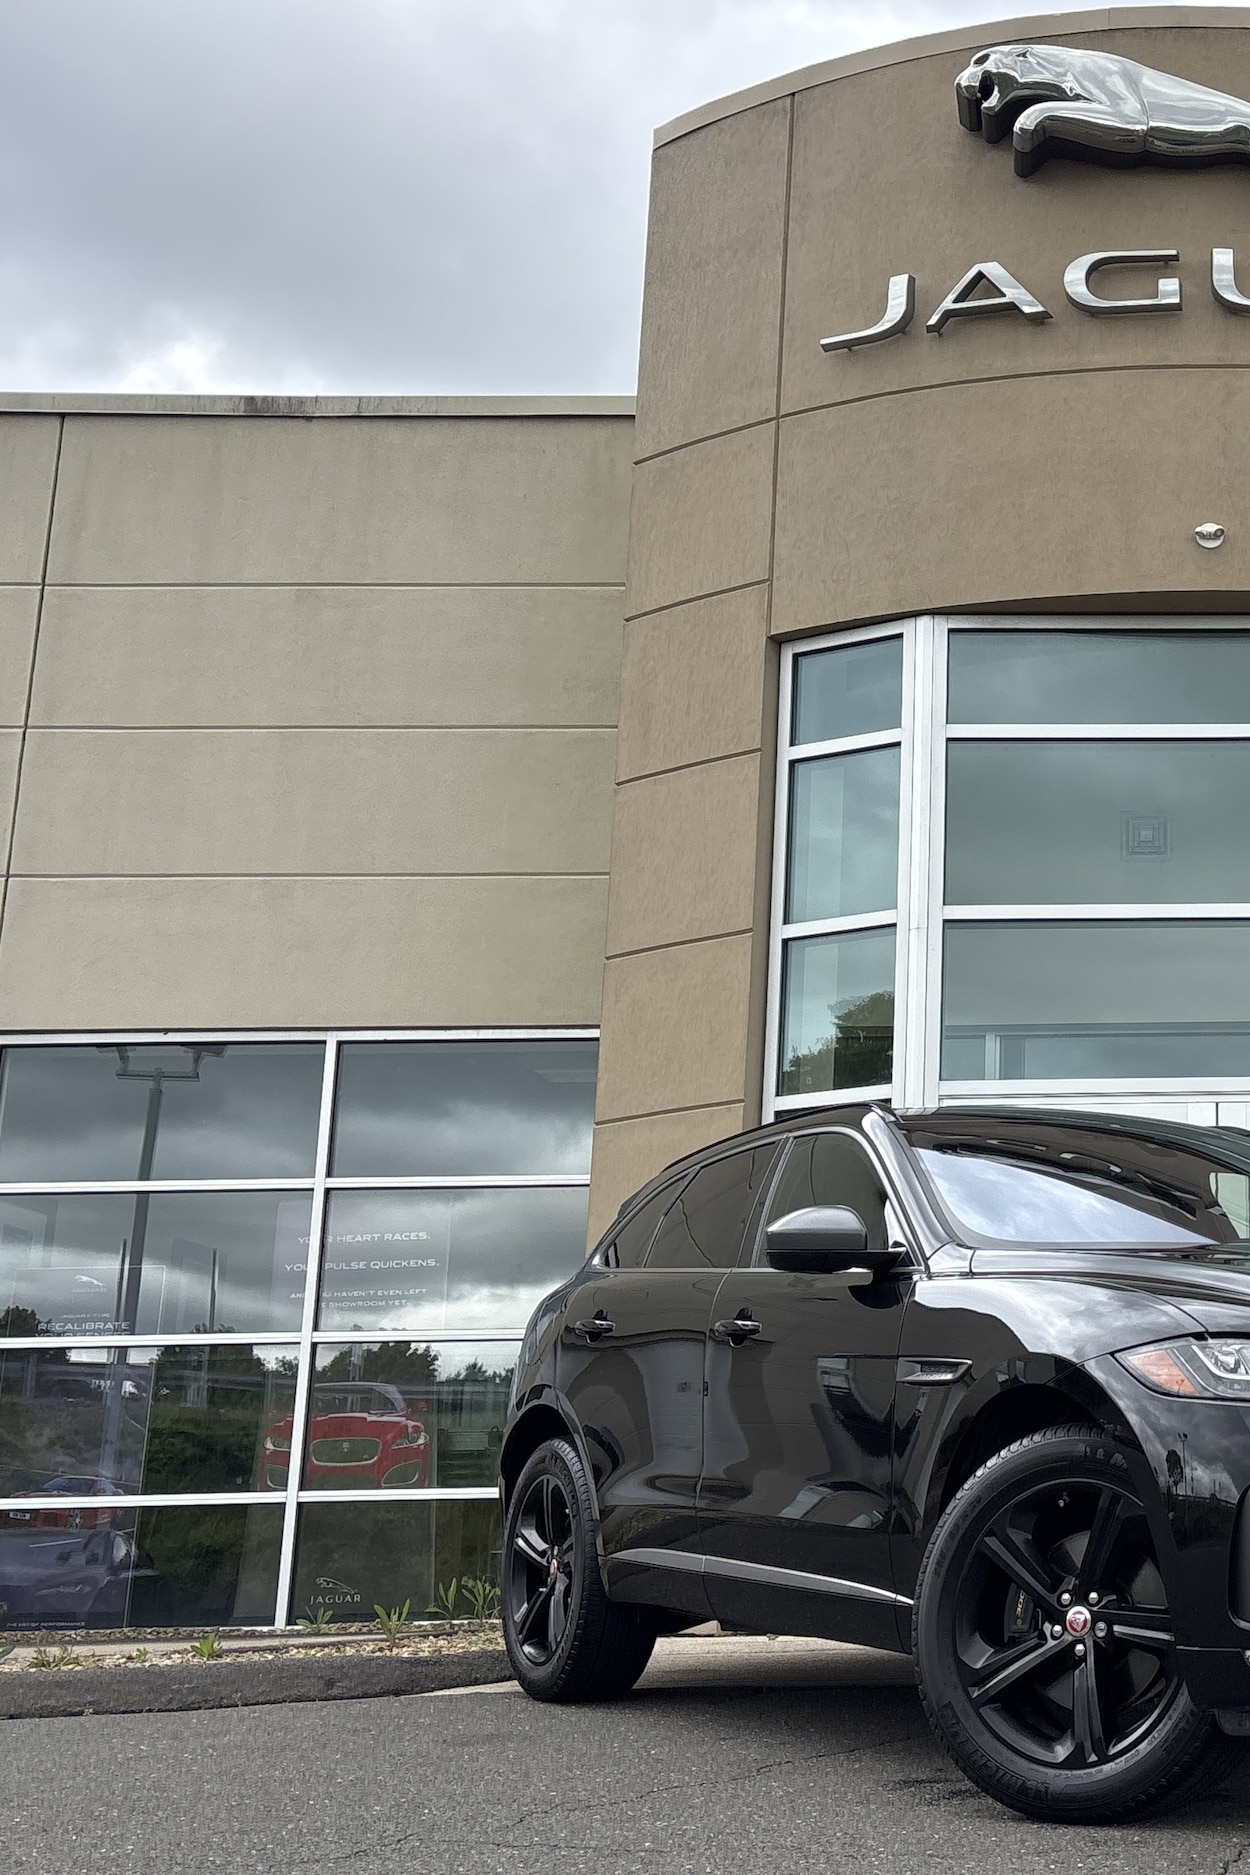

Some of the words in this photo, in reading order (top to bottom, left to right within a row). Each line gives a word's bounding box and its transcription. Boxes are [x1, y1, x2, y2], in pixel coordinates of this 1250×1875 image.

[297, 1235, 333, 1244] YOR
[336, 1234, 381, 1243] HEART
[384, 1231, 431, 1241] RACES.
[284, 1263, 308, 1272] YO
[324, 1261, 367, 1271] PULSE
[370, 1258, 439, 1270] QUICKENS.
[333, 1290, 376, 1298] HAVEN'T
[328, 1300, 386, 1308] SHOWROOM
[37, 1321, 130, 1331] RECALIBRATE
[309, 1593, 361, 1605] JAGUAR
